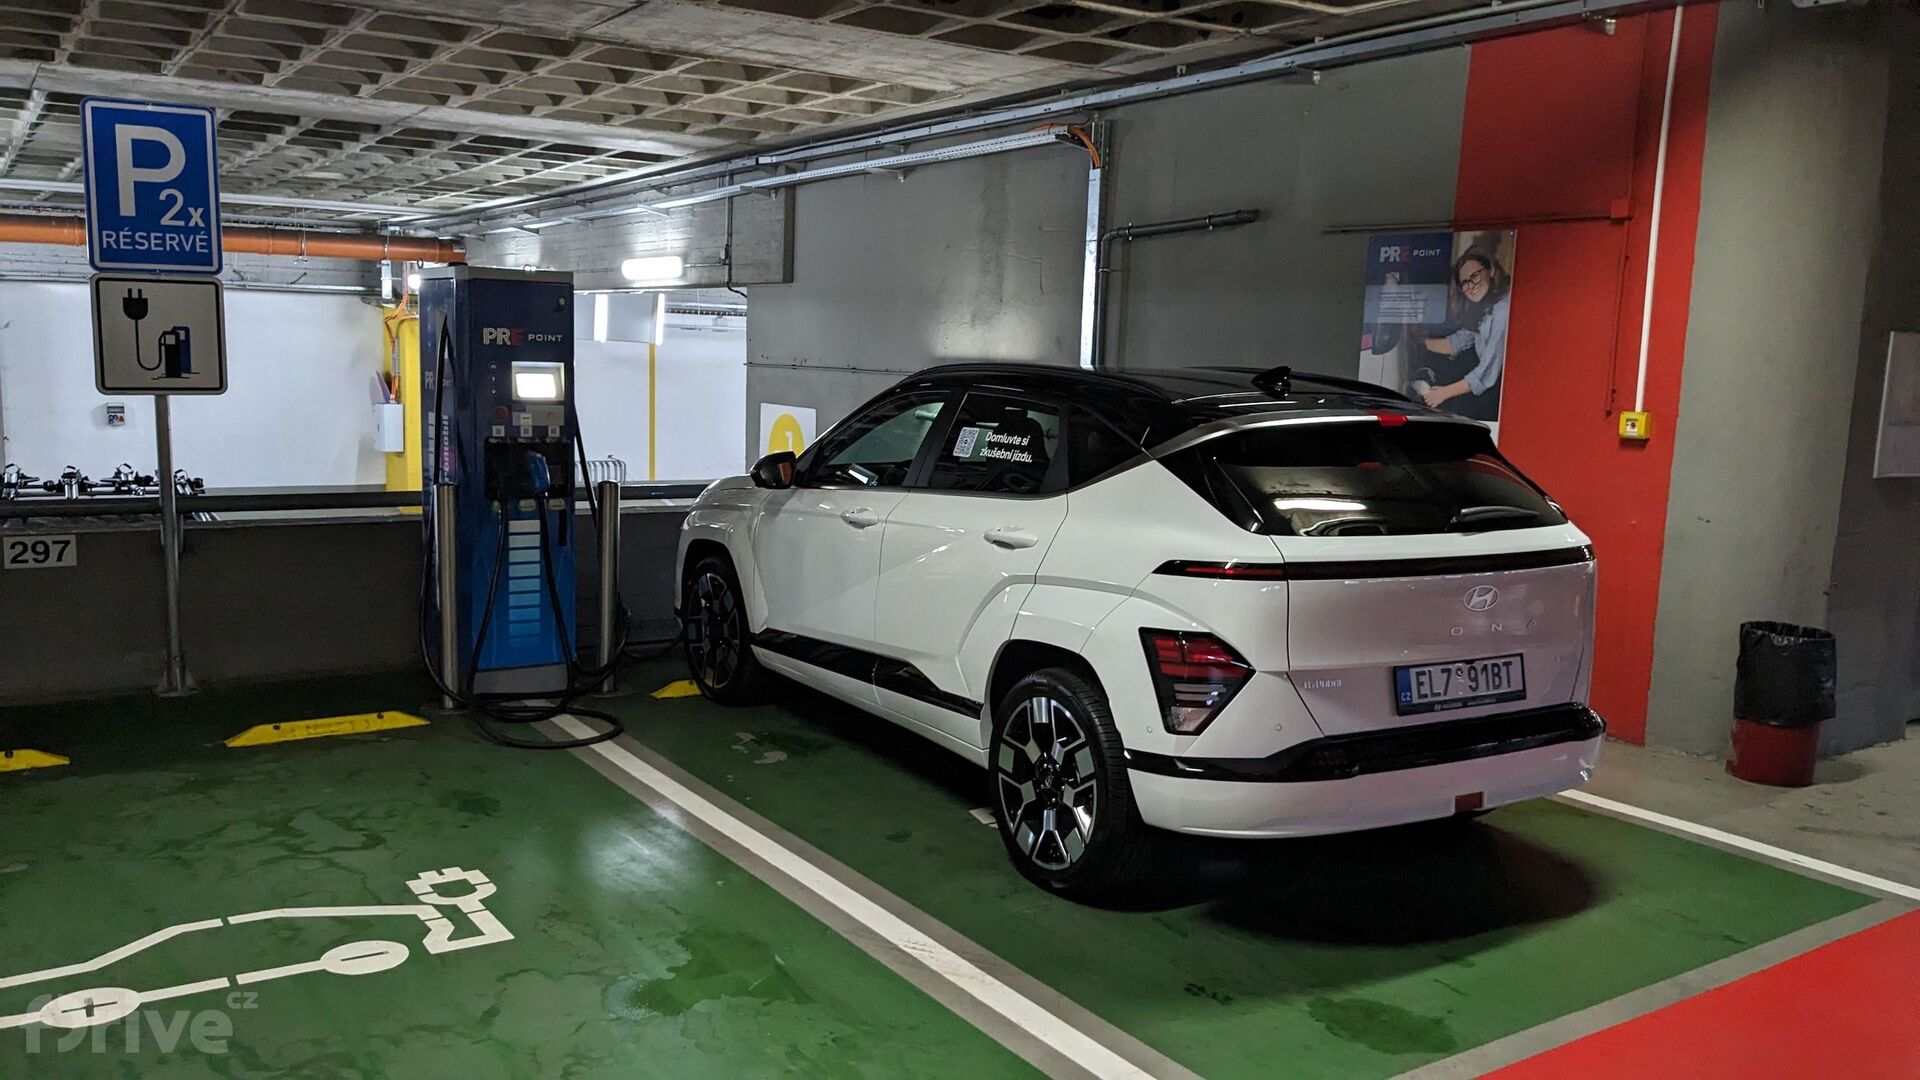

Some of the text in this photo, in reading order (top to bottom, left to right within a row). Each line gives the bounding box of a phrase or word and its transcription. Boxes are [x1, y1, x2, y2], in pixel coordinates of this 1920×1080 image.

[115, 123, 186, 217] P
[159, 188, 206, 228] 2x
[101, 226, 209, 253] RÉSERVÉ
[1379, 245, 1441, 262] PRE POINT
[482, 327, 562, 346] PRE POINT
[785, 431, 794, 450] 1
[985, 431, 1031, 446] Domluvte si
[979, 446, 1034, 463] zkušební jízdu.
[9, 540, 71, 564] 297
[1415, 661, 1513, 700] EL7 91BT
